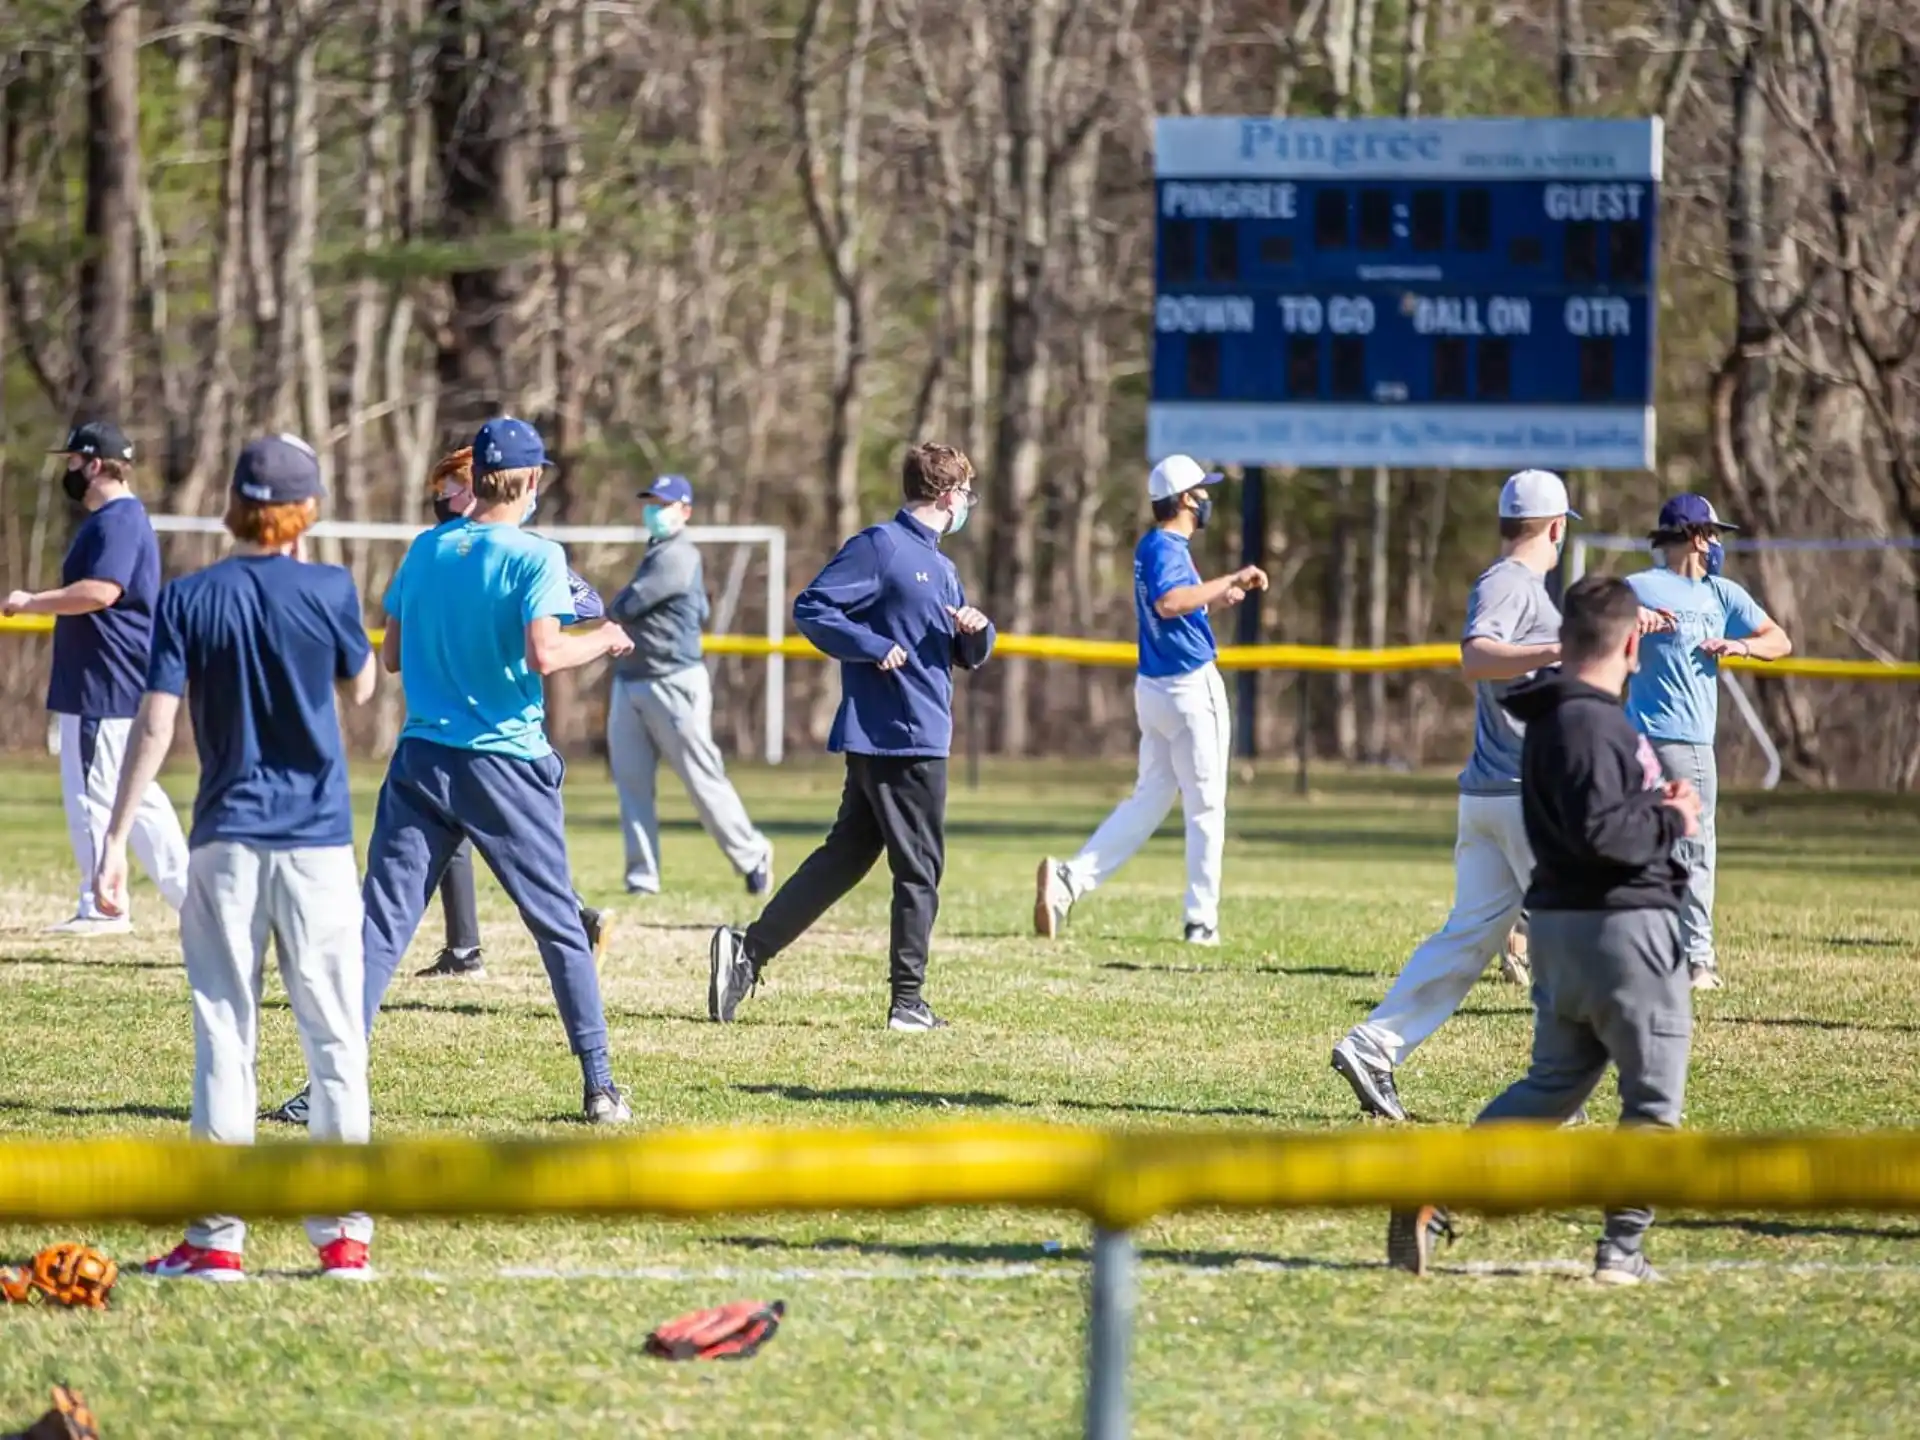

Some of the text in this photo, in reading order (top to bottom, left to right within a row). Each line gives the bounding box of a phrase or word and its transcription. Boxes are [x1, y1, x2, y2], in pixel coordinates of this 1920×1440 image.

[1240, 120, 1441, 170] Pingree
[1163, 181, 1297, 219] PINGREE
[1543, 183, 1645, 221] GUEST
[1156, 294, 1254, 333] DOWN
[1277, 295, 1375, 334] TO GO
[1413, 296, 1531, 334] BALL ON
[1564, 296, 1630, 336] QTR
